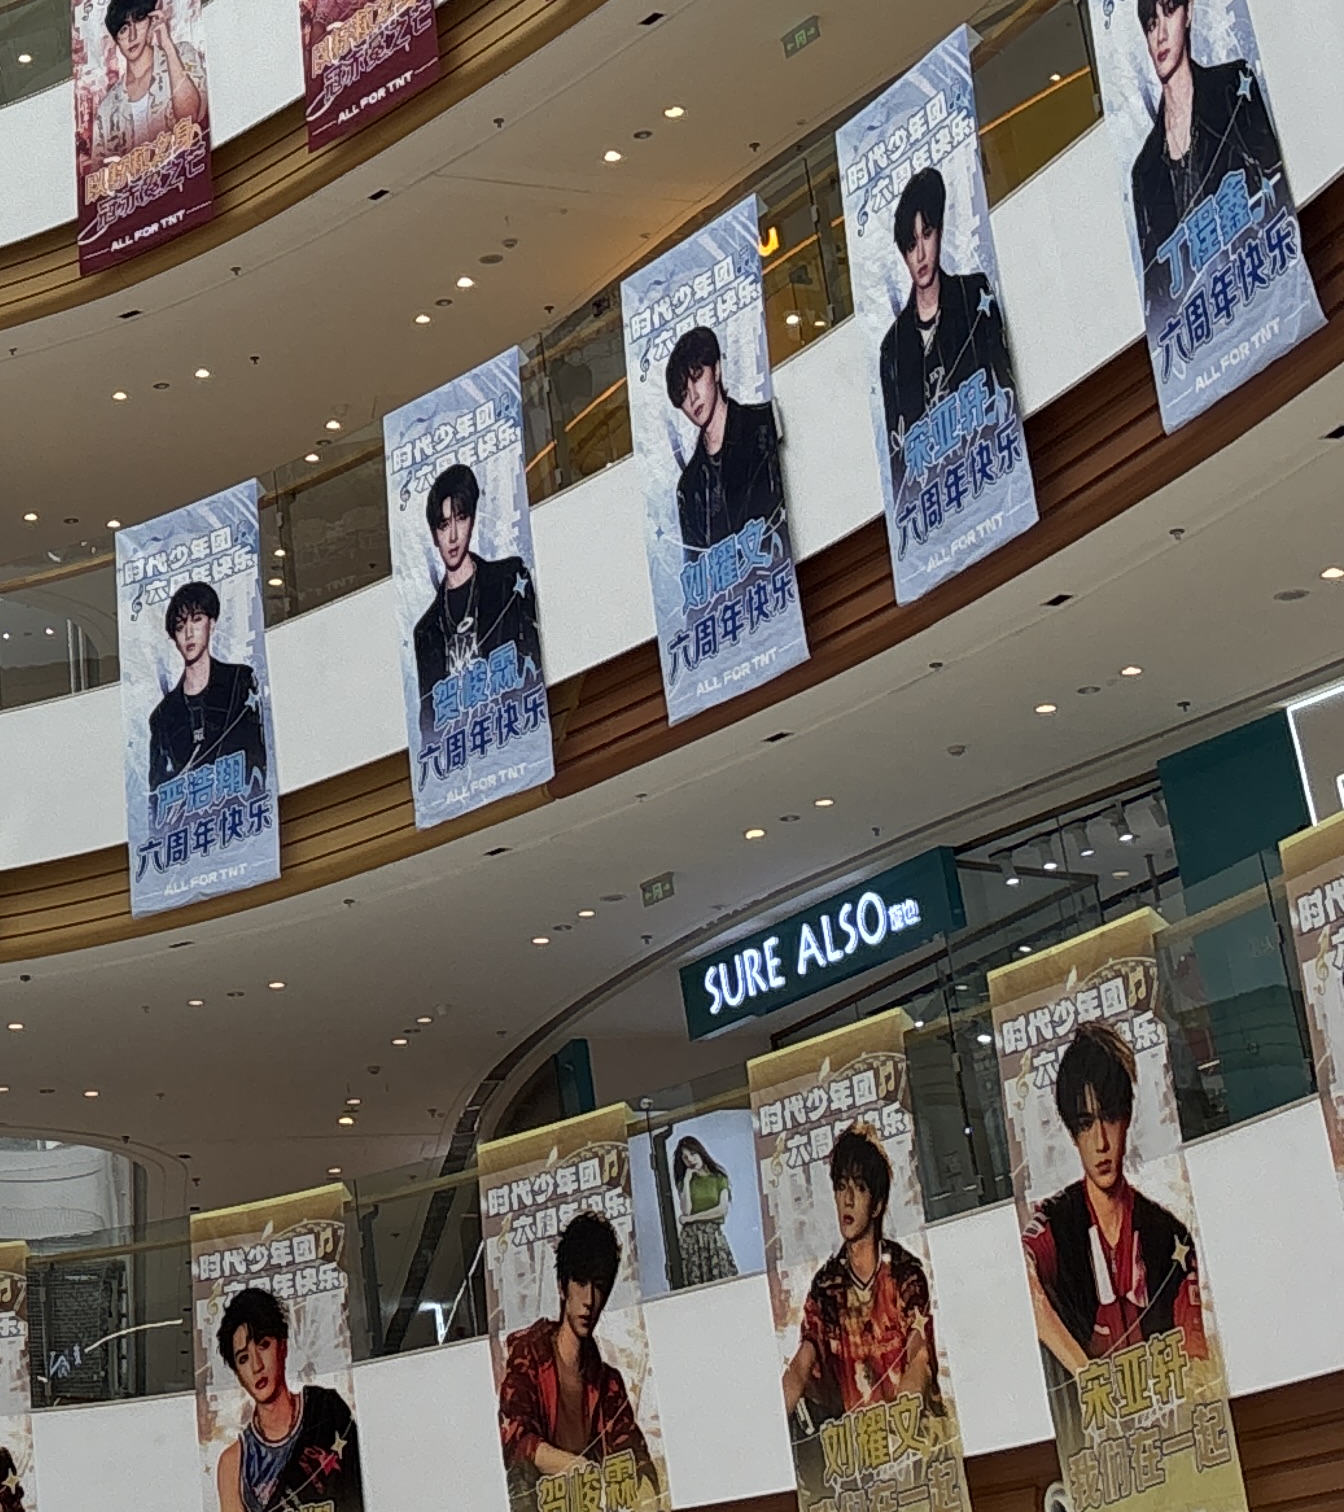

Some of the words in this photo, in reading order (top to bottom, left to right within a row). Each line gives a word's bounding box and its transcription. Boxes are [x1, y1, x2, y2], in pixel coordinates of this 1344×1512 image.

[847, 96, 946, 193] 时代少年团
[1158, 165, 1253, 299] 丁程鑫
[630, 256, 734, 341] 时代少年团
[1157, 207, 1301, 376] 六周年快乐
[393, 402, 494, 473] 时代少年团
[903, 370, 991, 483] 宋亚轩
[895, 423, 1023, 556] 六周年快乐
[123, 527, 230, 584] 时代少年团
[680, 516, 768, 613] 刘耀文
[666, 565, 794, 680] 六周年快乐
[432, 644, 518, 726] 贺峻霖
[418, 689, 545, 786] 六周年快乐
[137, 794, 271, 878] 六周年快乐
[159, 752, 246, 825] 严浩翔
[704, 936, 786, 1015] SURE
[797, 891, 888, 976] ALSO
[1002, 977, 1124, 1054] 时代少年团
[760, 1068, 875, 1136] 时代少年团
[487, 1152, 601, 1214] 时代少年团
[199, 1237, 315, 1281] 时代少年团
[1078, 1326, 1190, 1432] 宋亚轩
[822, 1392, 926, 1487] 刘耀文
[1068, 1401, 1231, 1511] 我们在一起
